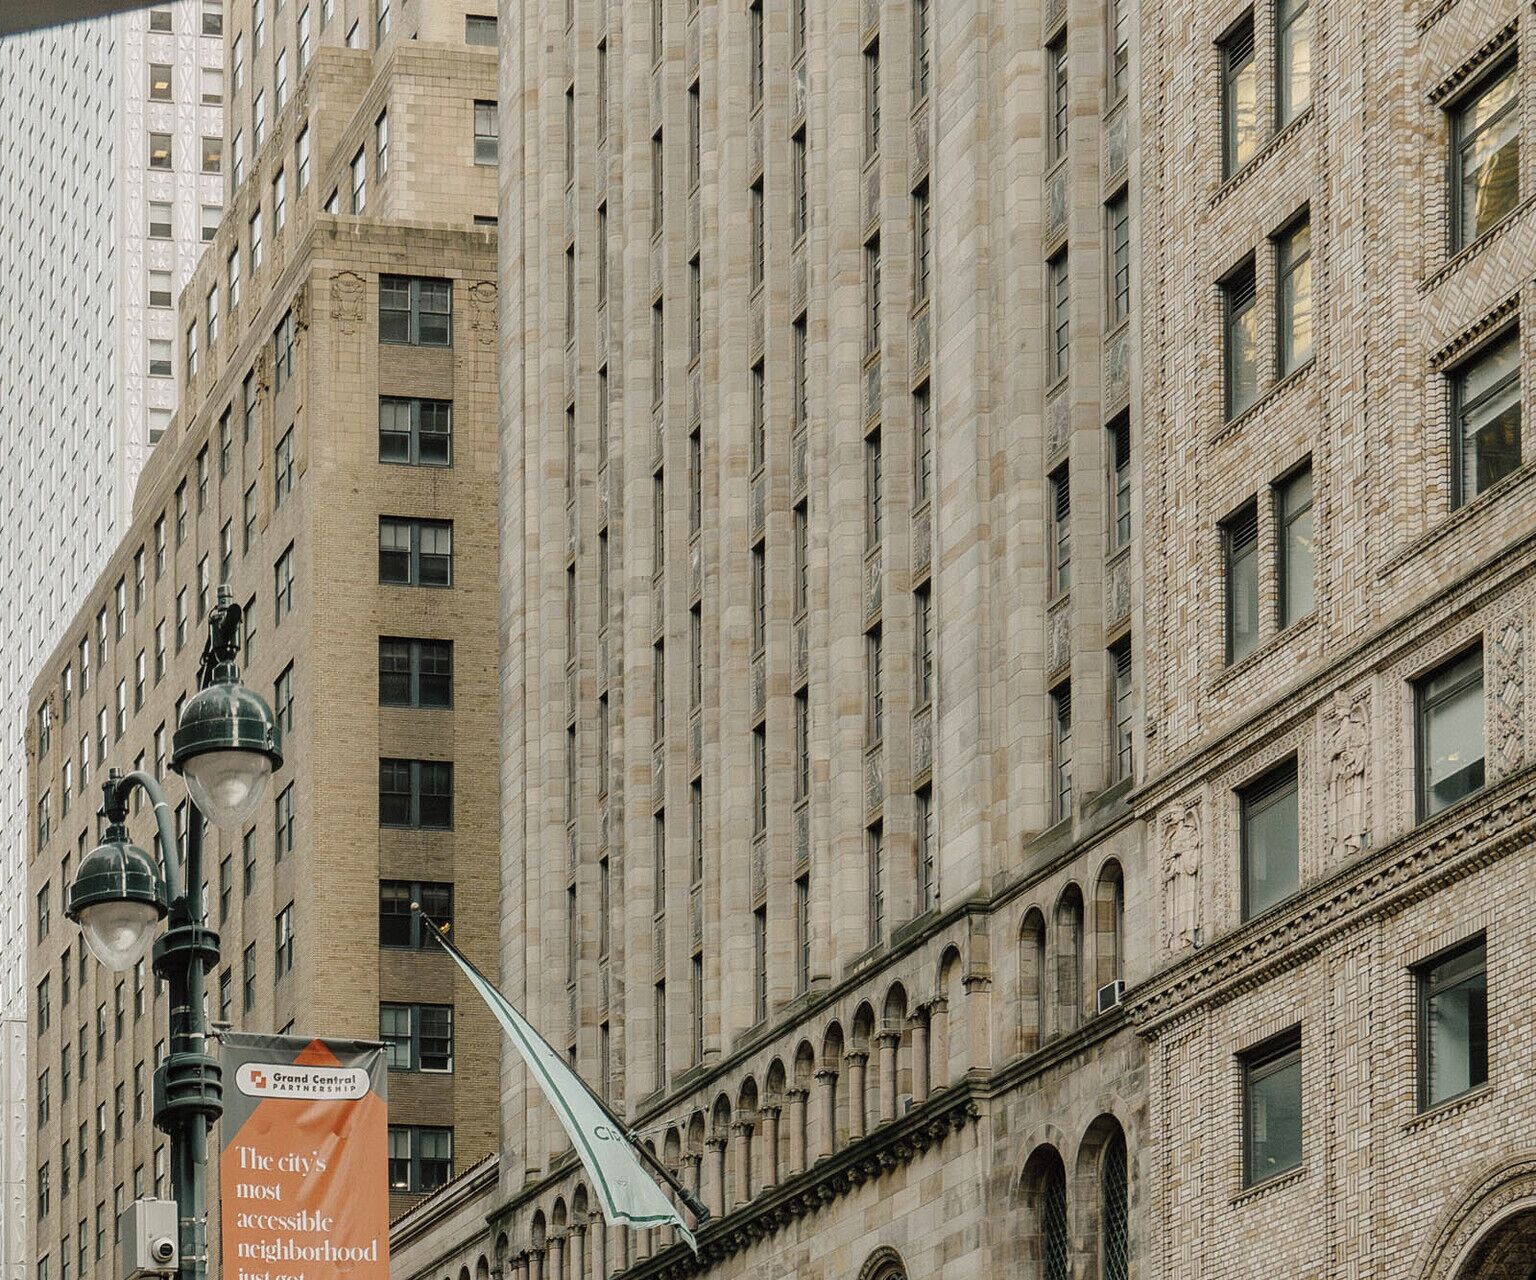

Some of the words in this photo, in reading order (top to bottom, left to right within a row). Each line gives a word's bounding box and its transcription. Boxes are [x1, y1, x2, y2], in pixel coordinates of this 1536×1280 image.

[272, 1083, 356, 1092] PARTNERSHIP
[273, 1072, 309, 1083] Grand
[313, 1074, 356, 1084] Central
[235, 1145, 274, 1171] The
[278, 1150, 327, 1177] city's
[236, 1181, 281, 1201] most
[237, 1209, 334, 1231] accessible
[237, 1238, 378, 1263] neighborhood
